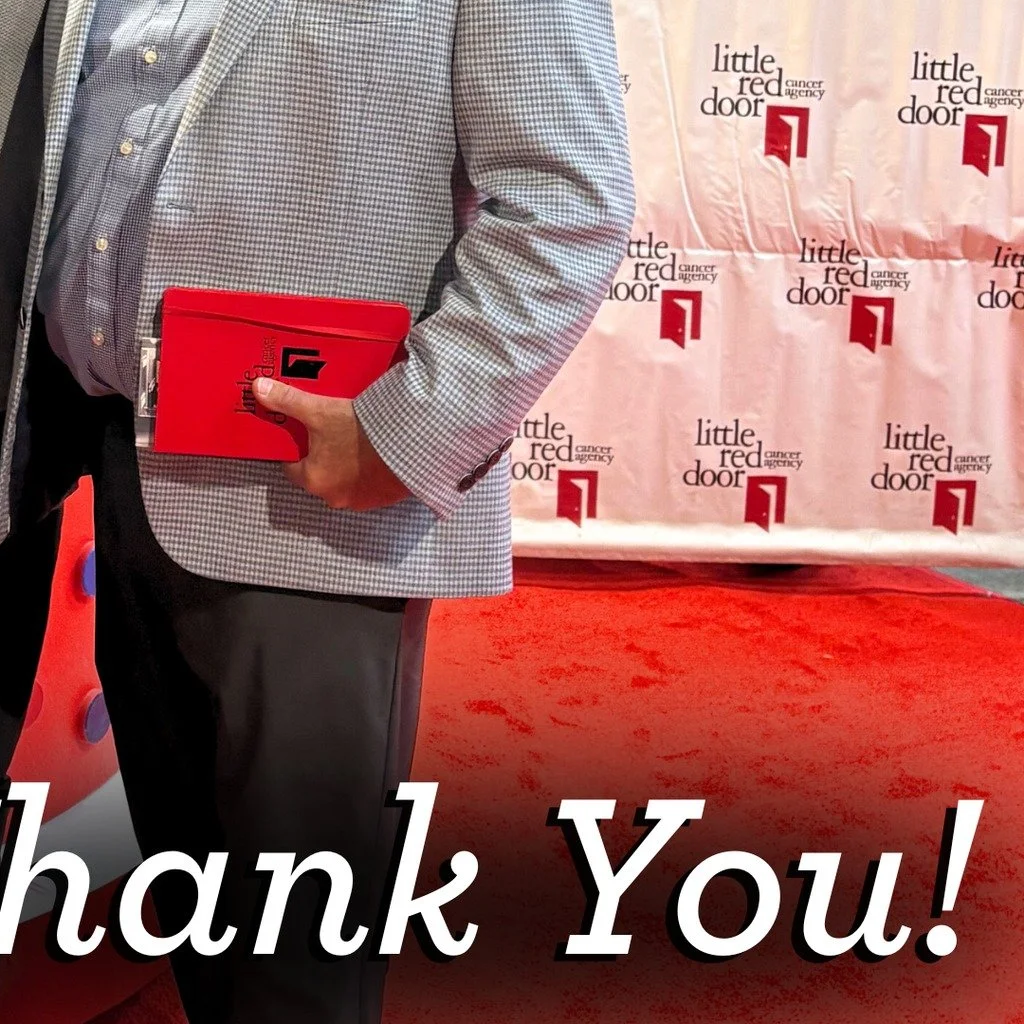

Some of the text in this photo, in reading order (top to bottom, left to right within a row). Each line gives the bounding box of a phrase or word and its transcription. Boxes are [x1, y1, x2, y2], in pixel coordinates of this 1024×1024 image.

[712, 43, 775, 74] little
[911, 51, 974, 82] little
[738, 68, 783, 97] red
[785, 80, 824, 89] cancer
[785, 88, 826, 101] agency
[936, 76, 982, 106] red
[984, 88, 1024, 97] cancer
[700, 86, 764, 117] door
[898, 95, 964, 126] door
[984, 97, 1024, 109] agency
[628, 232, 668, 259] ttle
[799, 237, 861, 265] little
[633, 252, 677, 282] red
[678, 264, 716, 273] cancer
[678, 273, 718, 284] agency
[823, 260, 869, 288] red
[872, 271, 909, 280] cancer
[786, 276, 850, 305] door
[870, 279, 911, 292] agency
[977, 284, 1024, 310] doo
[695, 418, 755, 447] little
[884, 423, 945, 452] little
[530, 434, 574, 462] red
[575, 454, 614, 465] agency
[576, 445, 612, 454] cancer
[719, 440, 762, 468] red
[908, 446, 952, 472] red
[512, 462, 556, 481] oor
[682, 460, 746, 488] door
[764, 459, 803, 470] agency
[871, 463, 934, 491] door
[954, 463, 992, 474] agency
